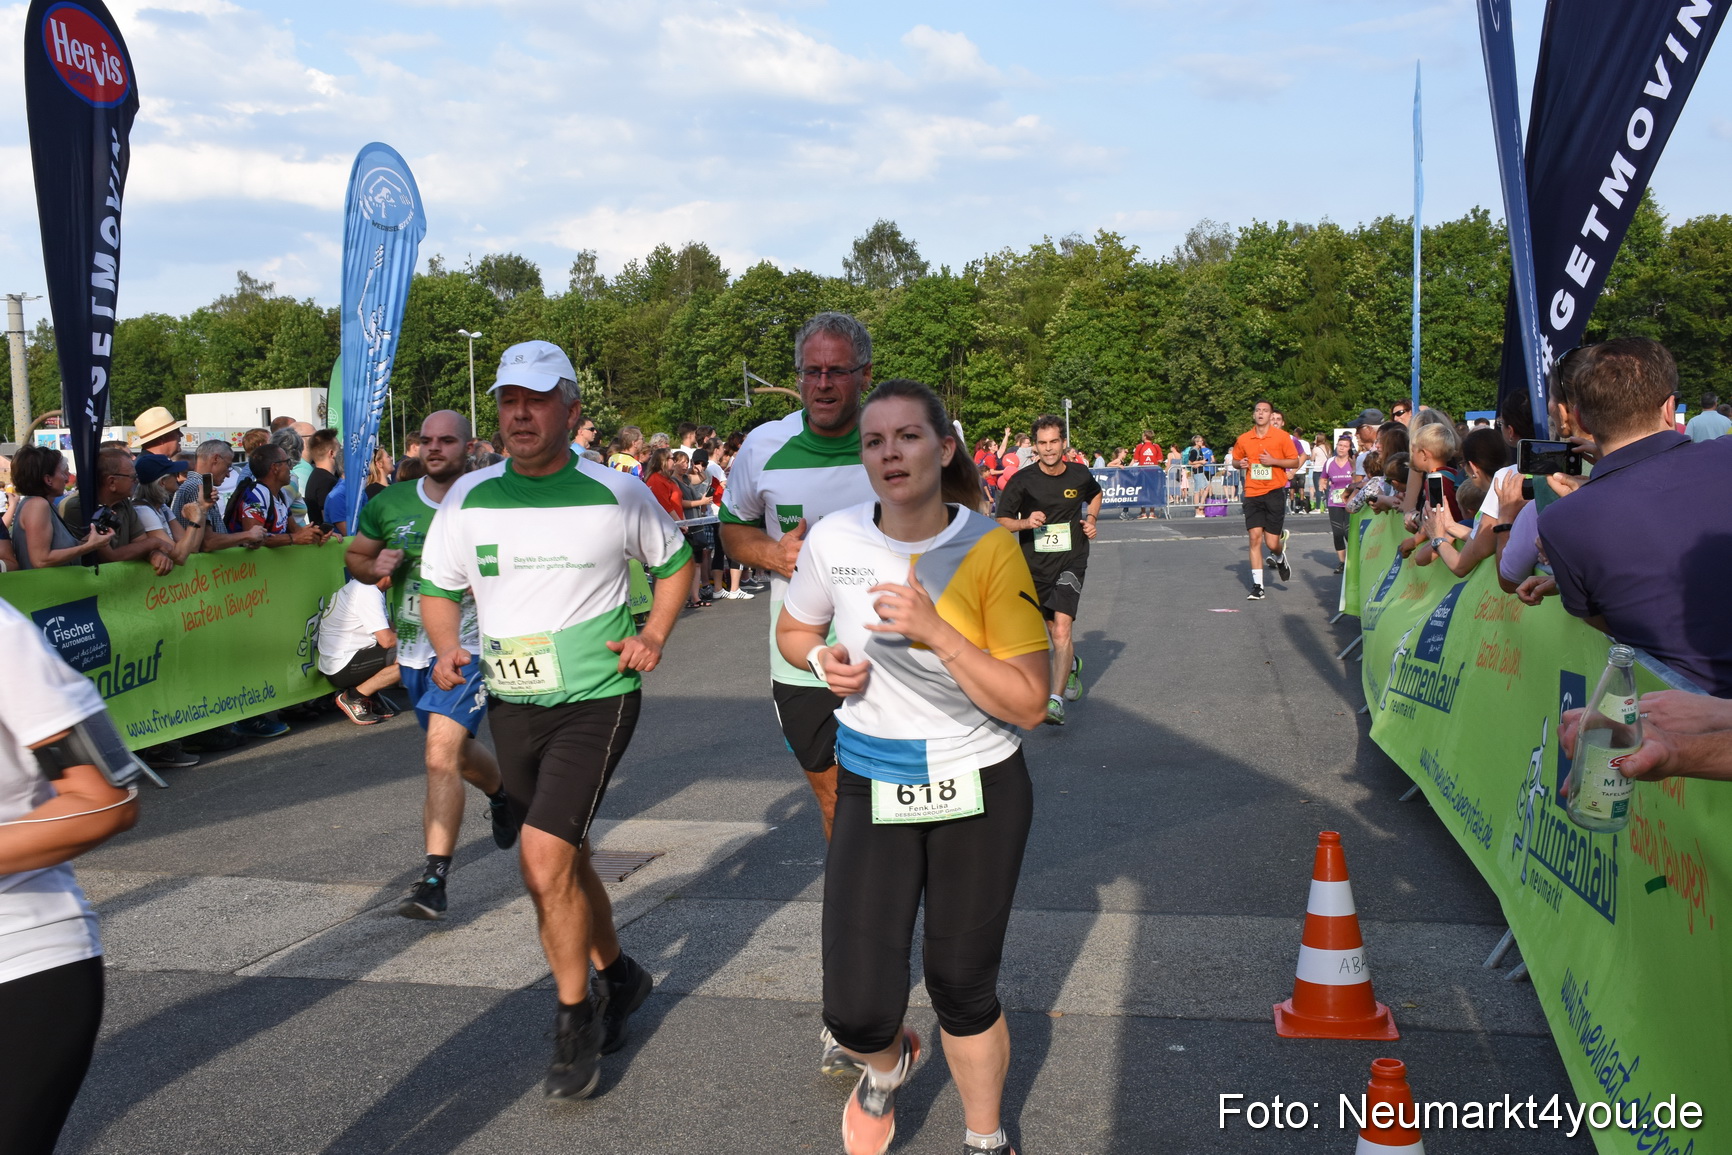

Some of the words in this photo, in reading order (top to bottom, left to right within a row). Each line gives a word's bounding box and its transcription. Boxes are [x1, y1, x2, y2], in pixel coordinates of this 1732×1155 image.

[49, 17, 124, 87] Hervis
[1044, 534, 1059, 545] 73
[831, 566, 875, 576] DESSIGN
[831, 577, 866, 586] GROUP
[145, 568, 210, 610] Gesunde
[211, 561, 257, 589] Firmen
[181, 599, 224, 633] laufen
[224, 578, 270, 618] länger!
[53, 622, 95, 643] Fischer
[61, 634, 97, 650] AUTOMOBILE
[495, 656, 541, 679] 114
[1396, 647, 1466, 711] firmenlauf
[126, 680, 277, 738] www.firmenlauf-oberpfalz.de
[1389, 699, 1417, 720] neumarkt
[896, 778, 957, 806] 618
[908, 804, 930, 812] Fenk
[931, 803, 949, 811] Lisa
[922, 809, 944, 817] GROUP
[1535, 785, 1619, 919] firmenlauf
[1529, 868, 1564, 914] neumarkt
